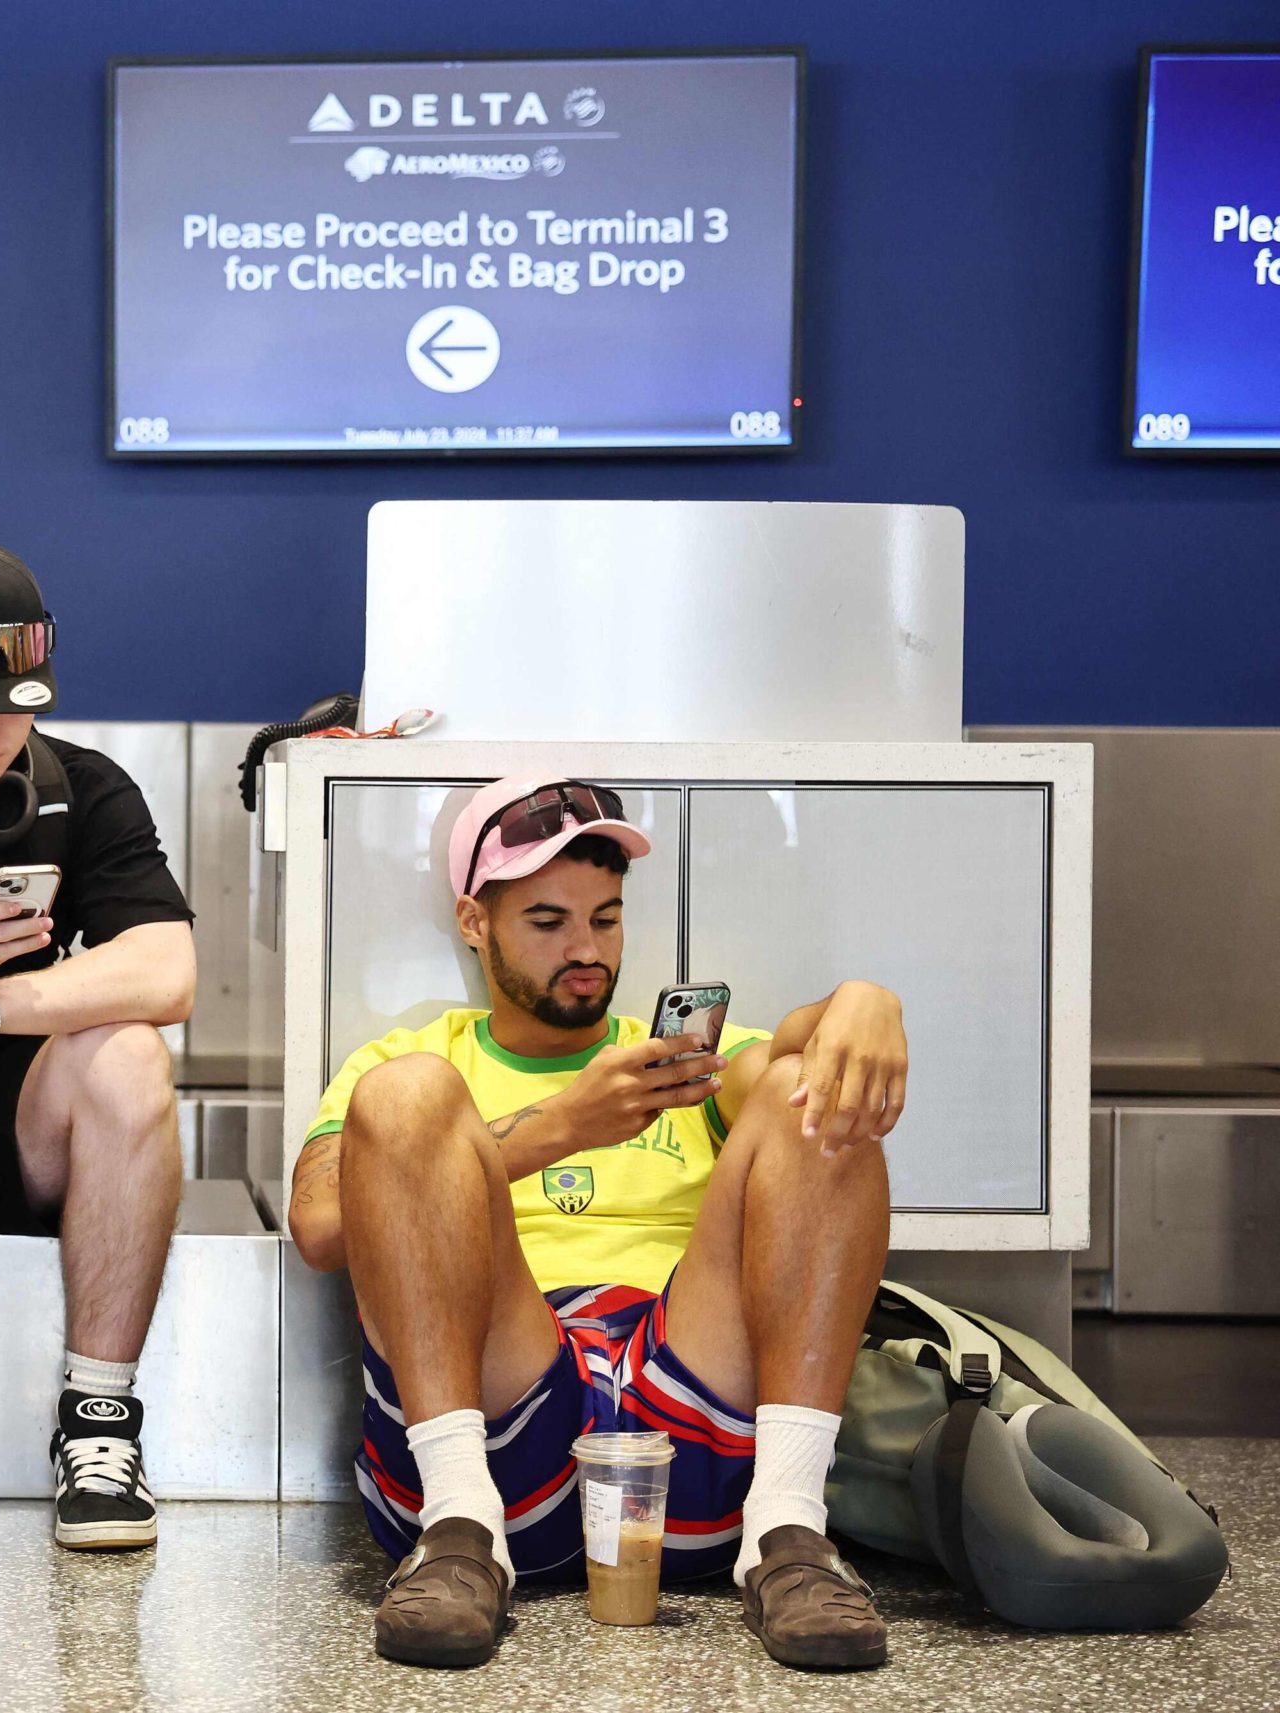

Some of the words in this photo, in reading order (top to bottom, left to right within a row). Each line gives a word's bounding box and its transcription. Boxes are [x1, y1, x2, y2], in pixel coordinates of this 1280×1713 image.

[369, 91, 549, 127] DELTA
[183, 212, 307, 249] Please
[315, 210, 468, 248] Proceed
[477, 212, 519, 247] to
[526, 206, 694, 246] Terminal
[703, 207, 729, 243] 3
[223, 254, 280, 291] for
[287, 253, 457, 291] Check-In
[465, 252, 500, 289] &
[508, 252, 580, 295] Bag
[588, 251, 686, 294] Drop
[730, 410, 781, 439] 088
[1138, 412, 1191, 442] 089
